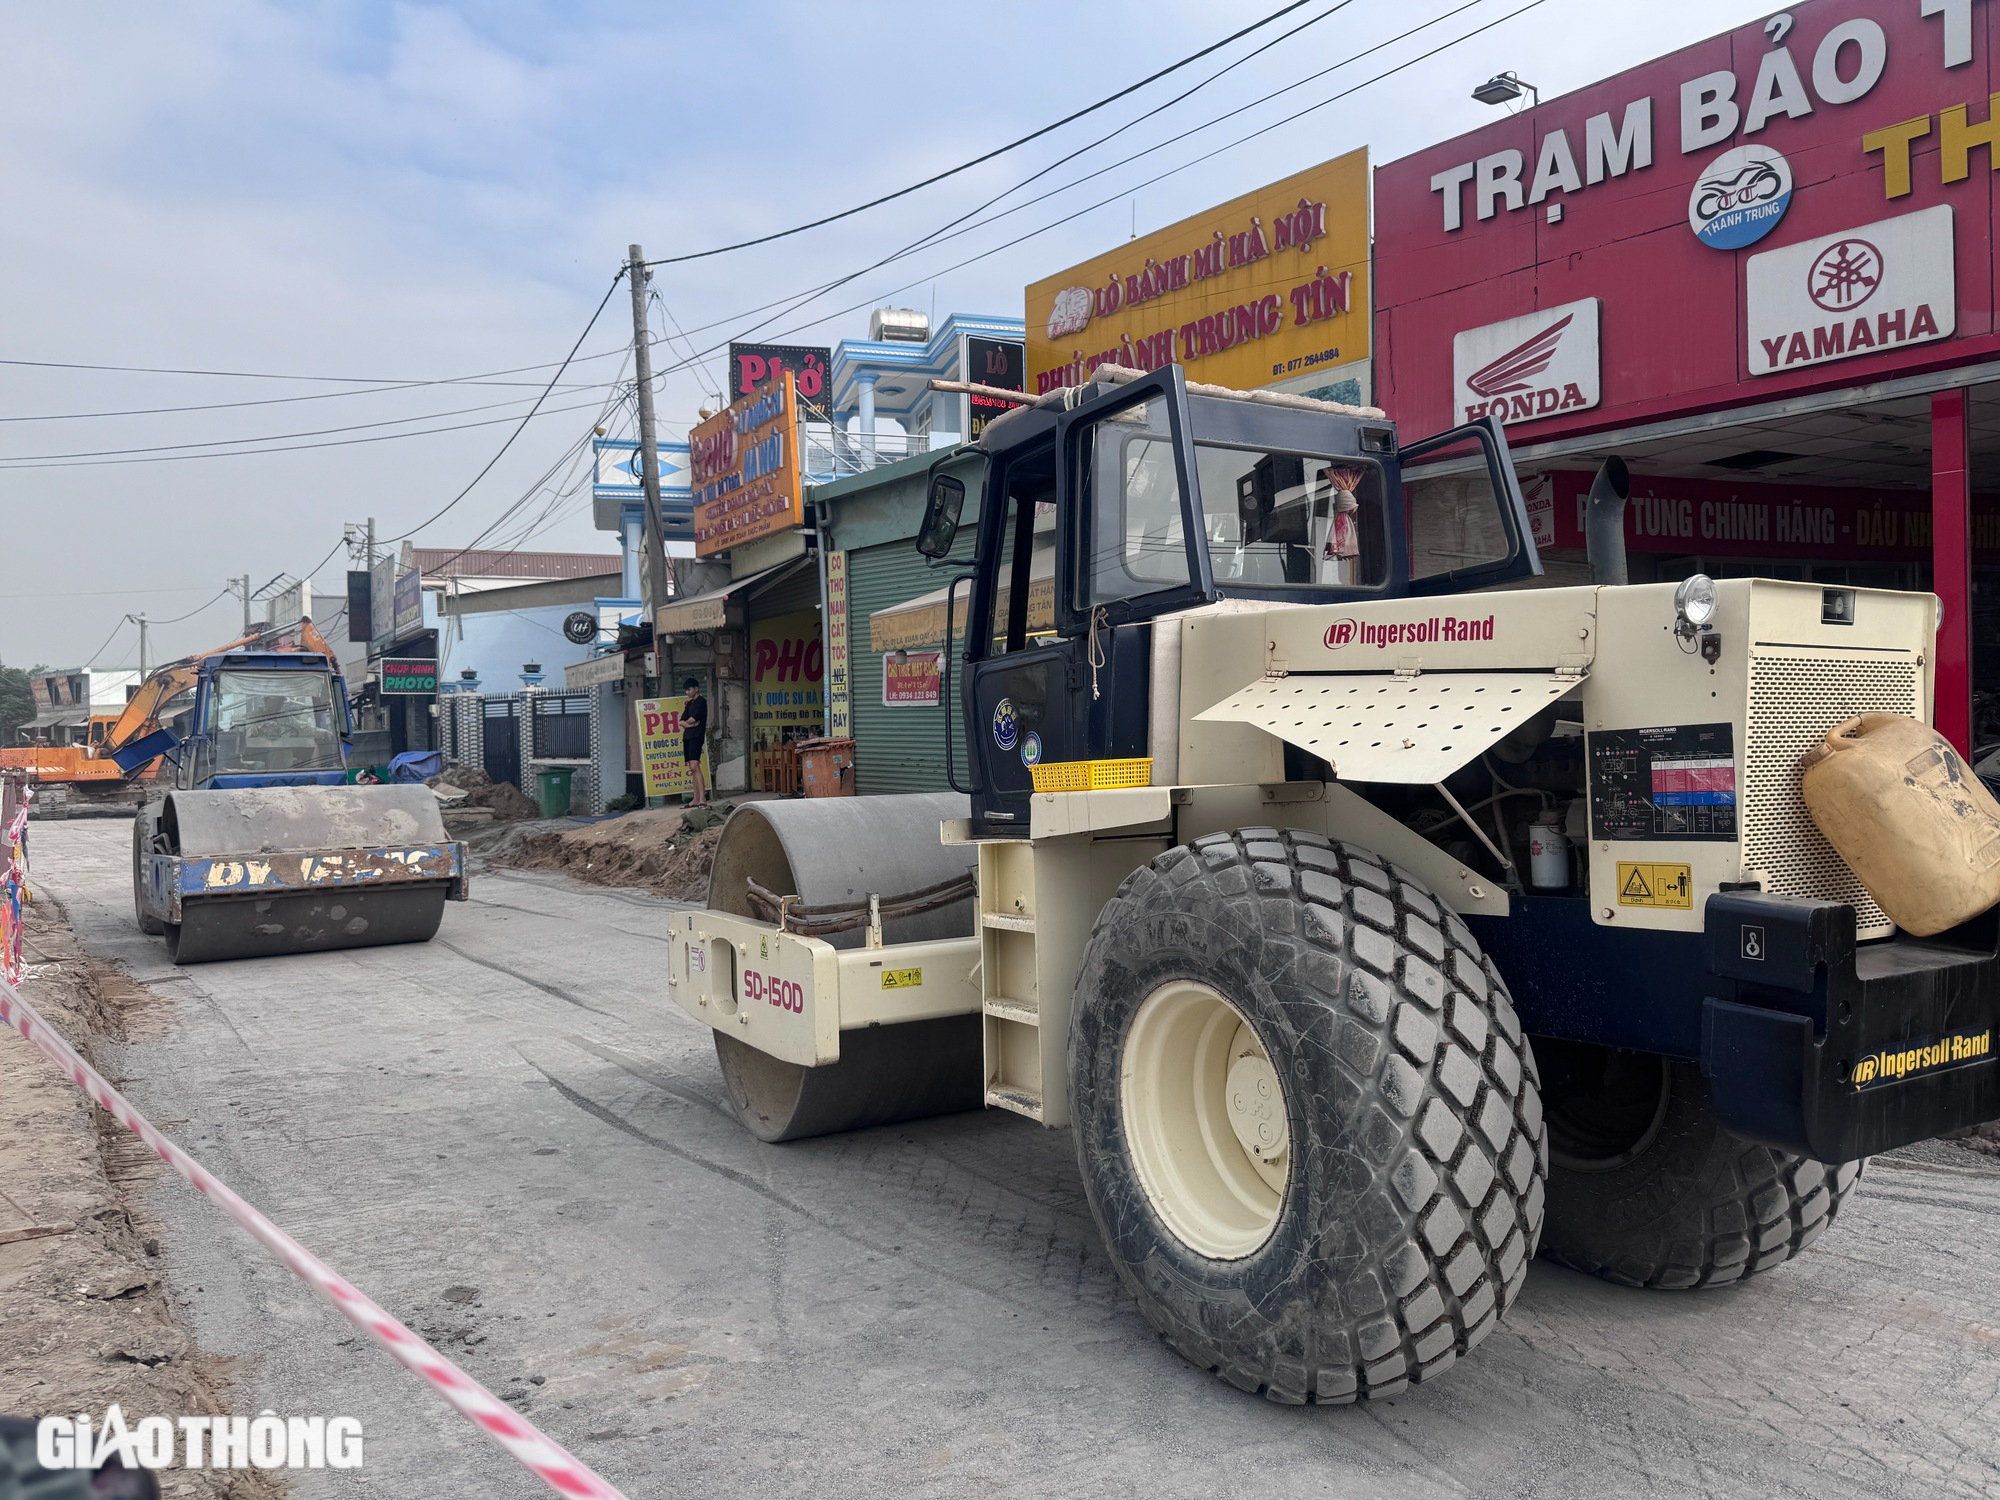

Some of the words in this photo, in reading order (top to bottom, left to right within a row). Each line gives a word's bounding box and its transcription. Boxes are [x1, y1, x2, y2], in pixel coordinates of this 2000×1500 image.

[1430, 96, 1654, 232] TRẠM
[1680, 14, 1887, 154] BẢO
[1704, 211, 1742, 237] THANH
[1744, 201, 1781, 223] TRUNG
[1095, 273, 1124, 318] LÒ
[1126, 257, 1191, 306] BÁNH
[1194, 231, 1226, 281] MÌ
[1228, 216, 1270, 268] HÀ
[1273, 198, 1327, 253] NỘI
[1180, 293, 1284, 361] TRUNG
[1290, 265, 1353, 327] TÍN
[1759, 303, 1939, 369] YAMAHA
[985, 345, 1008, 375] LÒ
[1287, 358, 1303, 373] 077
[1464, 382, 1587, 427] HONDA
[743, 434, 760, 488] HÀ
[760, 425, 784, 483] NỘI
[1632, 489, 1694, 538] TÙNG
[1700, 494, 1769, 542] CHÍNH
[1776, 498, 1835, 545] HÃNG
[830, 602, 846, 616] NAM
[831, 641, 846, 660] TÓC
[385, 676, 435, 690] PHOTO
[766, 688, 790, 708] QUỐC
[898, 691, 913, 700] 0934
[914, 691, 925, 699] 123
[925, 690, 937, 699] 849
[753, 709, 773, 720] Danh
[775, 708, 797, 721] Tiếng
[833, 709, 848, 728] RÁY
[652, 769, 682, 781] MIẾN
[744, 969, 804, 1014] SD-150D
